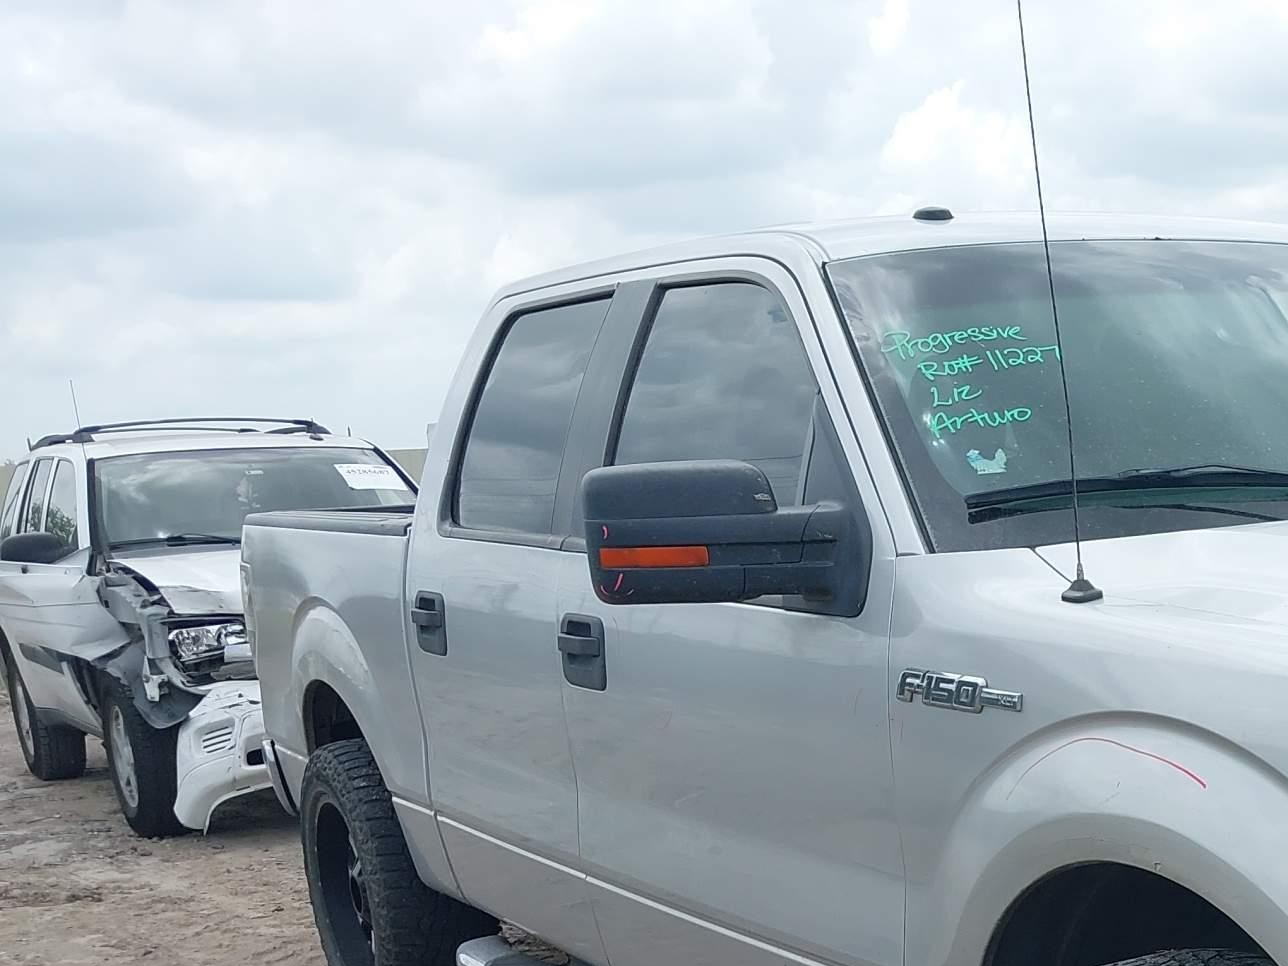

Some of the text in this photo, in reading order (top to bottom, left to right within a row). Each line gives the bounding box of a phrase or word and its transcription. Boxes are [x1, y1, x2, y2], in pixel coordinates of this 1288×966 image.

[881, 326, 1028, 360] Progressive
[986, 344, 1061, 371] 11227
[928, 408, 1032, 438] Arturo
